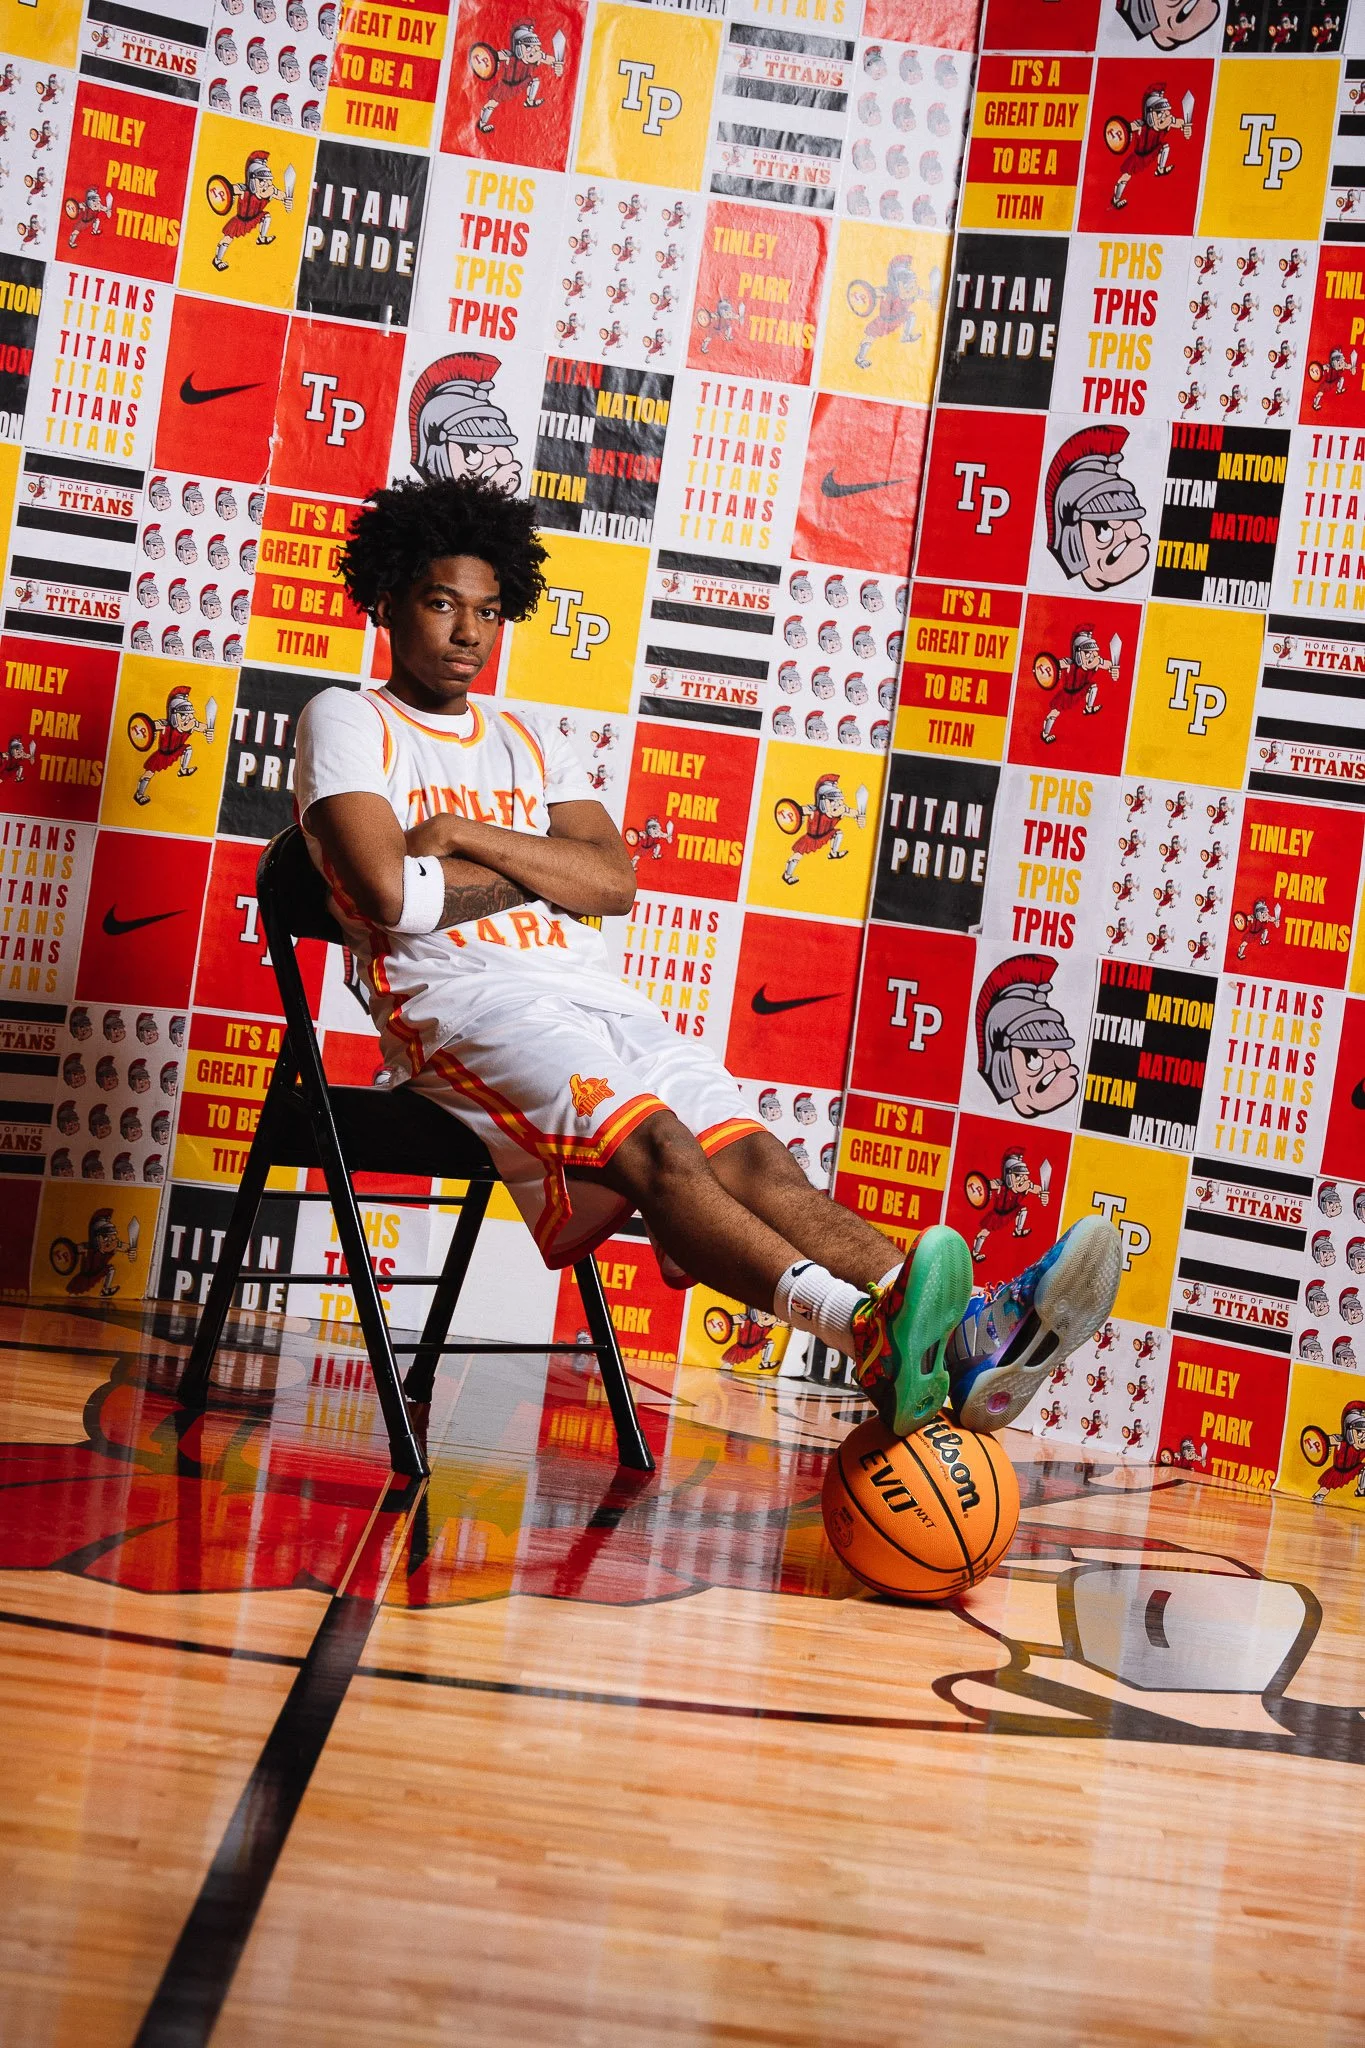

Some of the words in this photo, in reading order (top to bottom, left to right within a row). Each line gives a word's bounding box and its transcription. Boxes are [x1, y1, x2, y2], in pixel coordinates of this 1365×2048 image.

[123, 35, 152, 46] HOME
[180, 49, 198, 58] THE
[398, 17, 437, 45] DAY
[122, 42, 196, 75] TITANS
[341, 53, 364, 81] TO
[369, 57, 395, 86] BE
[399, 63, 413, 89] A
[765, 61, 843, 87] TITANS
[1010, 59, 1043, 87] IT'S
[1048, 60, 1060, 86] A
[619, 59, 683, 136] TP
[985, 101, 1039, 126] GREAT
[1043, 103, 1079, 129] DAY
[82, 108, 146, 148] TINLEY
[346, 100, 398, 131] TITAN
[993, 147, 1014, 174] TO
[1018, 148, 1040, 174] BE
[1044, 149, 1057, 175] A
[1240, 113, 1302, 189] TP
[106, 160, 158, 198] PARK
[753, 159, 831, 184] TITANS
[466, 169, 535, 215] TPHS
[997, 194, 1043, 220] TITAN
[116, 208, 180, 247] TITANS
[460, 212, 529, 257] TPHS
[713, 226, 778, 259] TINLEY
[305, 230, 415, 273] PRIDE
[1098, 242, 1164, 281] TPHS
[68, 272, 155, 312] TITANS
[454, 254, 523, 298] TPHS
[739, 270, 790, 304] PARK
[957, 273, 1051, 313] TITAN
[62, 300, 152, 342] TITANS
[448, 298, 517, 340] TPHS
[1094, 288, 1158, 327] TPHS
[749, 314, 815, 349] TITANS
[959, 318, 1055, 360] PRIDE
[59, 330, 147, 370] TITANS
[1088, 331, 1153, 370] TPHS
[53, 358, 144, 399] TITANS
[51, 388, 138, 427] TITANS
[301, 372, 366, 446] TP
[596, 390, 669, 425] NATION
[701, 381, 789, 416] TITANS
[1082, 377, 1148, 416] TPHS
[46, 417, 136, 458] TITANS
[538, 410, 595, 443] TITAN
[696, 406, 786, 443] TITANS
[1172, 422, 1224, 450] TITAN
[692, 434, 781, 469] TITANS
[1217, 452, 1286, 484] NATION
[60, 483, 88, 492] HOME
[530, 469, 587, 503] TITAN
[688, 459, 779, 496] TITANS
[1164, 477, 1217, 509] TITAN
[58, 491, 134, 516] TITANS
[684, 487, 774, 522] TITANS
[954, 461, 1011, 536] TP
[290, 501, 323, 529] IT'S
[331, 509, 346, 534] A
[579, 509, 652, 543] NATION
[680, 514, 770, 549] TITANS
[1210, 512, 1278, 543] NATION
[262, 538, 319, 570] GREAT
[1157, 539, 1209, 571] TITAN
[46, 587, 76, 596] HOME
[272, 584, 296, 610] TO
[300, 589, 325, 615] BE
[330, 592, 343, 617] A
[693, 586, 770, 609] TITANS
[694, 579, 723, 587] HOME
[1201, 576, 1272, 609] NATION
[46, 595, 120, 619] TITANS
[942, 588, 974, 616] IT'S
[978, 592, 991, 618] A
[547, 586, 610, 660] TP
[277, 630, 329, 659] TITAN
[916, 627, 971, 655] GREAT
[975, 633, 1009, 661] DAY
[5, 660, 68, 695] TINLEY
[681, 681, 757, 705] TITANS
[925, 672, 945, 699] TO
[949, 676, 972, 702] BE
[975, 678, 988, 705] A
[1167, 657, 1227, 736] TP
[29, 709, 80, 741] PARK
[928, 719, 975, 747] TITAN
[39, 754, 104, 787] TITANS
[641, 746, 706, 779] TINLEY
[666, 792, 720, 823] PARK
[1029, 775, 1094, 817] TPHS
[890, 792, 983, 838] TITAN
[677, 833, 743, 866] TITANS
[1024, 819, 1087, 861] TPHS
[1250, 823, 1315, 857] TINLEY
[890, 838, 987, 885] PRIDE
[1018, 862, 1082, 905] TPHS
[1274, 871, 1327, 904] PARK
[630, 901, 719, 933] TITANS
[1012, 905, 1076, 949] TPHS
[626, 926, 716, 959] TITANS
[1285, 918, 1351, 953] TITANS
[623, 952, 712, 985] TITANS
[1101, 958, 1153, 991] TITAN
[887, 977, 943, 1052] TP
[1145, 993, 1213, 1030] NATION
[1235, 982, 1325, 1019] TITANS
[225, 1023, 263, 1049] IT'S
[1093, 1013, 1145, 1047] TITAN
[1230, 1009, 1321, 1048] TITANS
[198, 1059, 258, 1089] GREAT
[1138, 1052, 1206, 1088] NATION
[1228, 1038, 1316, 1076] TITANS
[1085, 1073, 1136, 1108] TITAN
[1223, 1066, 1313, 1106] TITANS
[875, 1102, 908, 1131] IT'S
[911, 1109, 923, 1135] A
[1219, 1095, 1307, 1134] TITANS
[1129, 1115, 1197, 1150] NATION
[1215, 1124, 1305, 1164] TITANS
[850, 1139, 902, 1170] GREAT
[907, 1150, 941, 1177] DAY
[858, 1184, 879, 1211] TO
[882, 1189, 903, 1216] BE
[907, 1195, 920, 1220] A
[1226, 1196, 1302, 1224] TITANS
[1227, 1188, 1256, 1198] HOME
[1264, 1194, 1277, 1202] OF
[1284, 1198, 1303, 1207] THE
[1213, 1299, 1289, 1328] TITANS
[1214, 1290, 1244, 1301] HOME
[1271, 1302, 1290, 1310] THE
[1177, 1361, 1240, 1399] TINLEY
[1200, 1411, 1253, 1448] PARK
[859, 1448, 918, 1514] EVO
[914, 1508, 935, 1528] NXT
